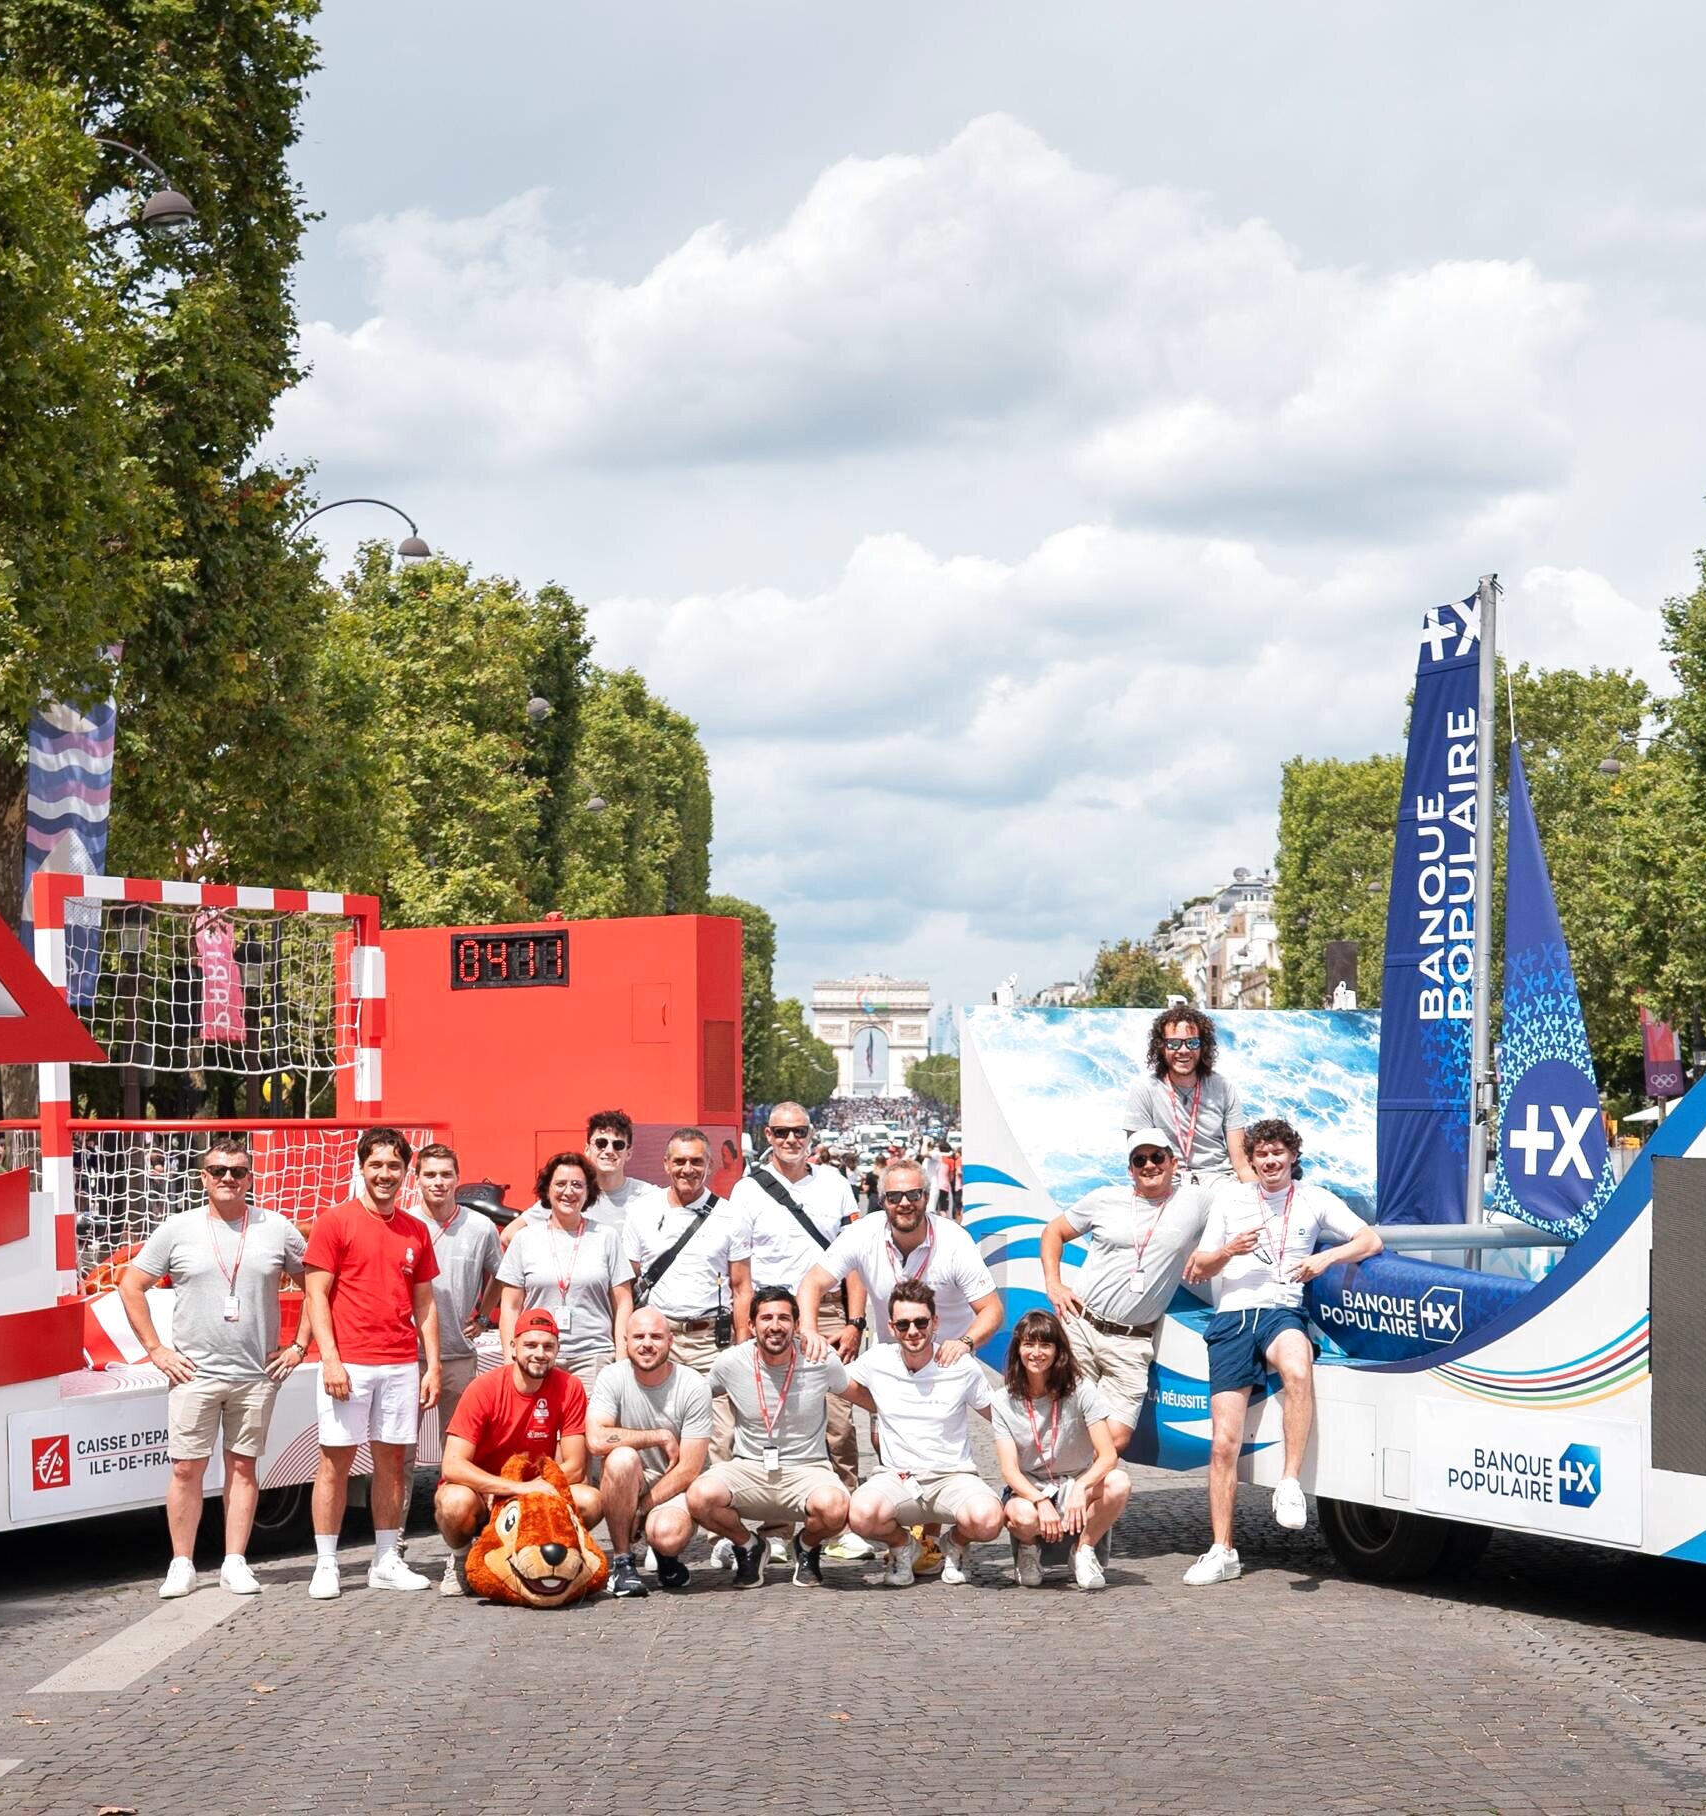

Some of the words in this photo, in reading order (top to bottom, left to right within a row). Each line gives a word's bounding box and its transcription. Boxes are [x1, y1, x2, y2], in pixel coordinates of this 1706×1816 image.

[1447, 706, 1477, 1020] POPULAIRE
[1416, 791, 1446, 1020] BANQUE
[1341, 1289, 1417, 1318] BANQUE
[1319, 1303, 1420, 1339] POPULAIRE
[1161, 1389, 1208, 1410] RÉUSSITE
[76, 1434, 127, 1455] CAISSE
[89, 1450, 173, 1476] ILE-DE-FRA
[1474, 1448, 1553, 1479] BANQUE
[1448, 1467, 1553, 1503] POPULAIRE
